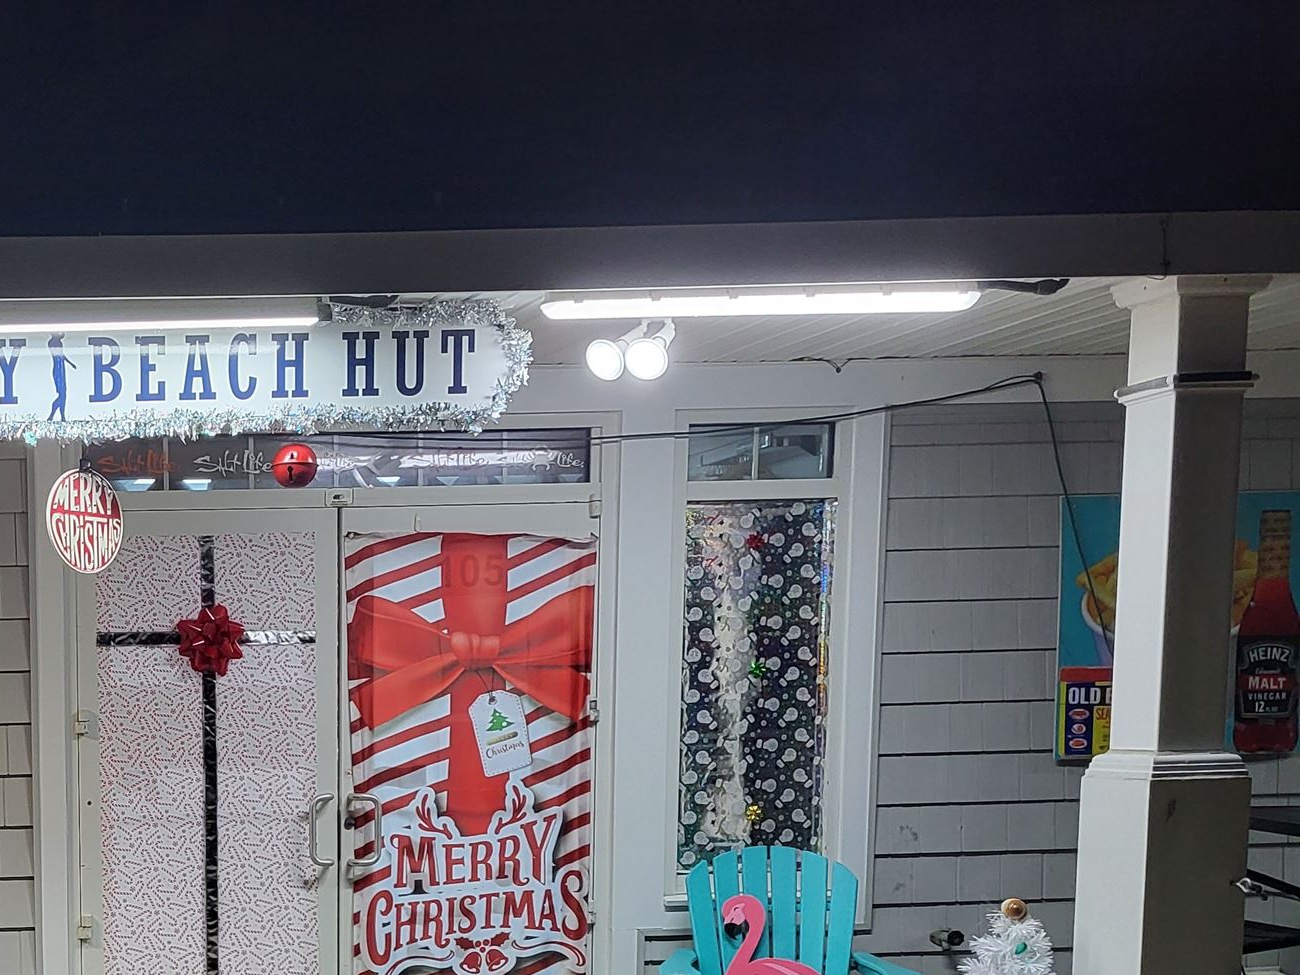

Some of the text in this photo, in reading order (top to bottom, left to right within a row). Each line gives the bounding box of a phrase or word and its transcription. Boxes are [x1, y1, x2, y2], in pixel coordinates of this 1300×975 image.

[87, 332, 310, 403] BEACH
[342, 328, 476, 397] HUT
[53, 473, 114, 515] MERRY
[52, 512, 121, 571] CHRISTMAS
[445, 554, 503, 588] 105
[1248, 646, 1291, 662] HEINZ
[1068, 687, 1101, 705] OLD
[1247, 675, 1288, 690] MALT
[1247, 692, 1287, 700] VINEGAR
[390, 813, 558, 889] MERRY
[365, 869, 589, 966] CHRISTMAS
